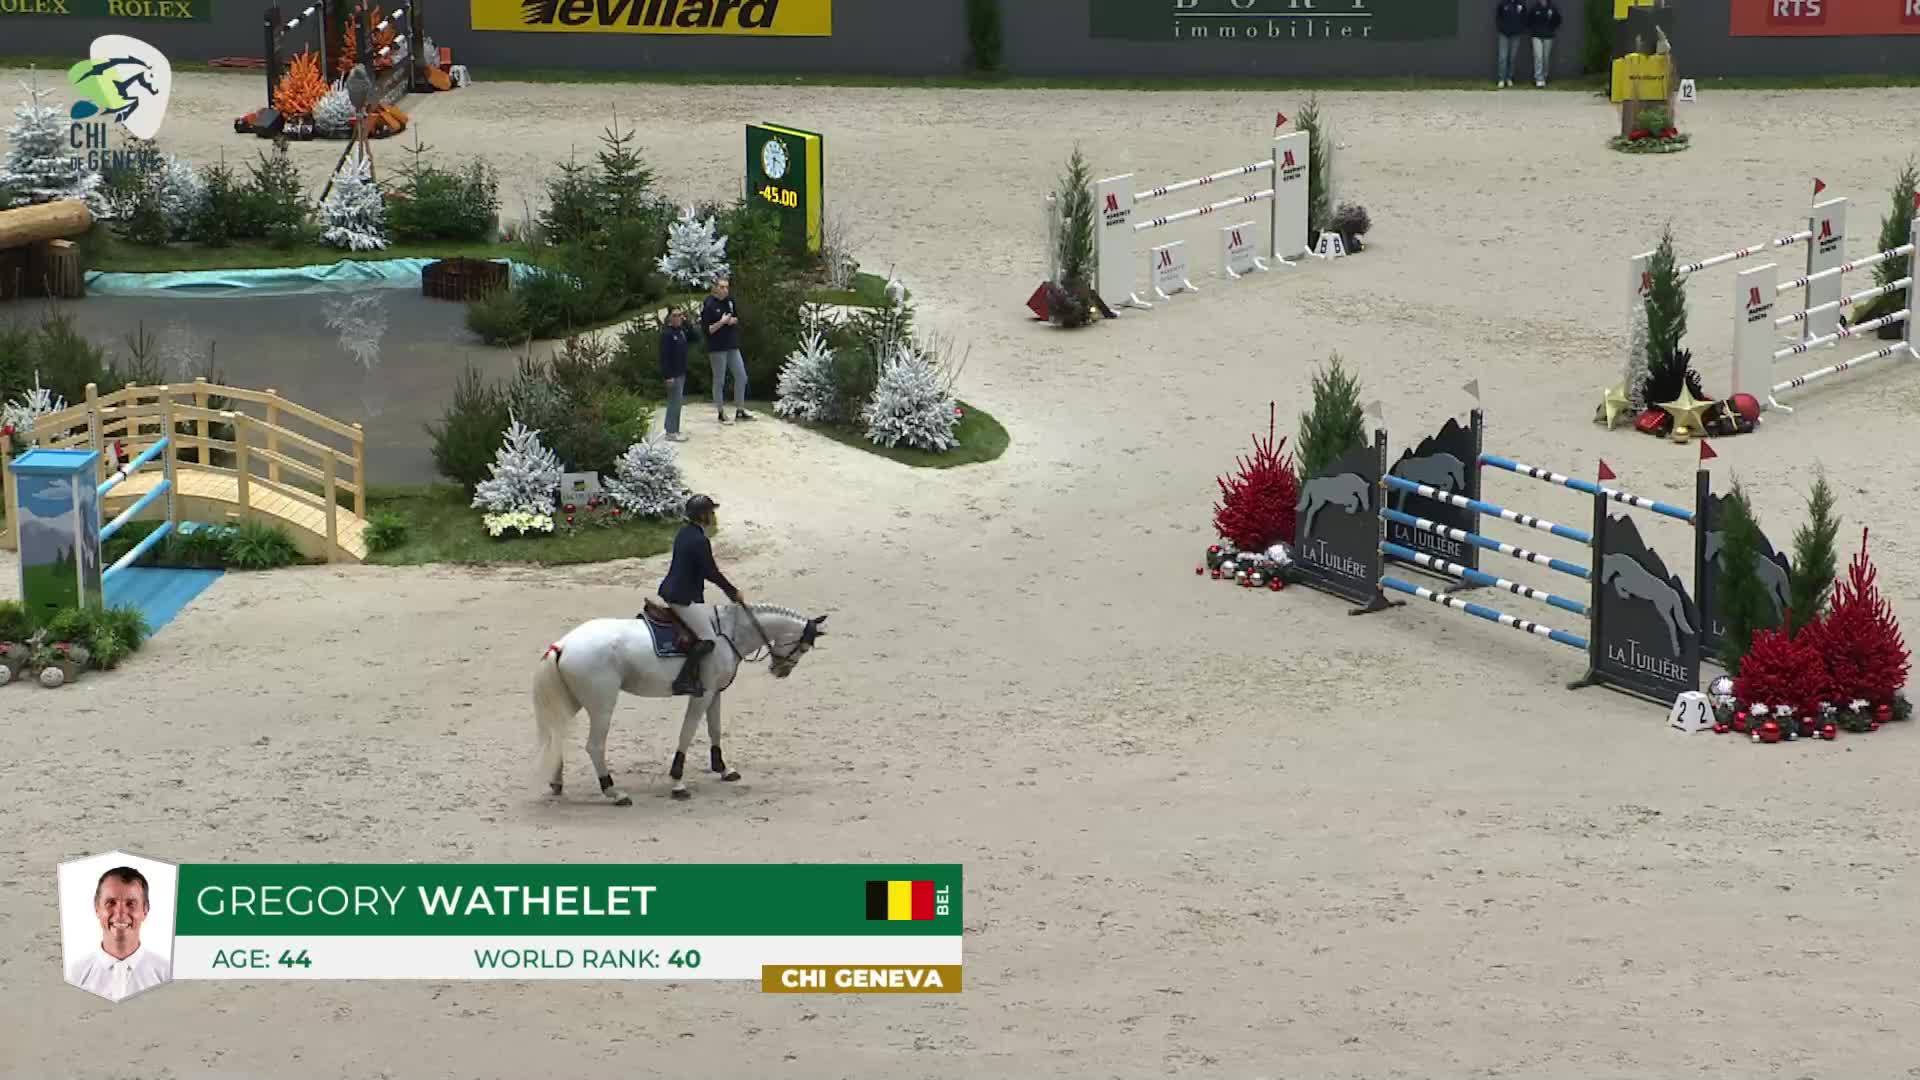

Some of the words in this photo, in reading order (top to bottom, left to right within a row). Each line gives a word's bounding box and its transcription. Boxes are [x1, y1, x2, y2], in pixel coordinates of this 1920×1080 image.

[0, 0, 70, 14] OLEX
[108, 0, 193, 18] ROLEX
[1773, 0, 1821, 17] RTS
[1175, 19, 1373, 38] immobilier
[1682, 83, 1694, 98] 12
[1394, 523, 1409, 541] LA
[1303, 544, 1317, 562] LA
[1608, 643, 1625, 663] LA
[1677, 701, 1687, 722] 2
[1697, 701, 1708, 724] 2
